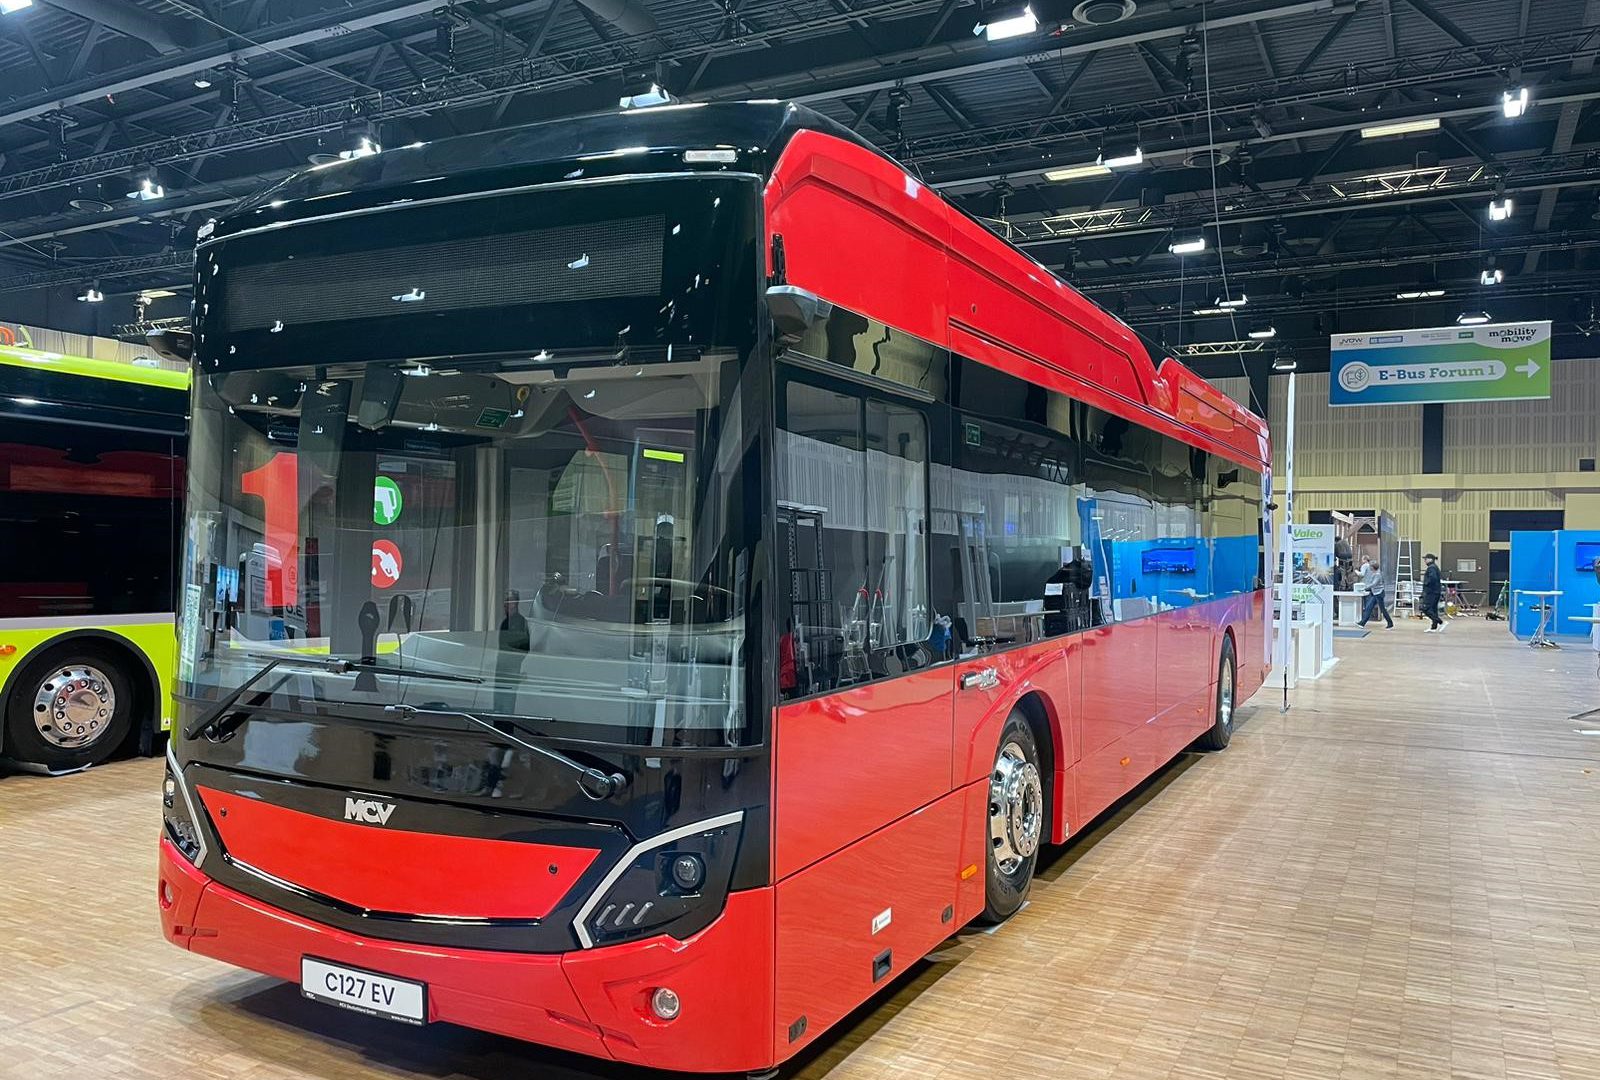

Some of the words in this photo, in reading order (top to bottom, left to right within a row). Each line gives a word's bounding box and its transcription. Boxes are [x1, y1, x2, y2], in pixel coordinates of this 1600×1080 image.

[1489, 327, 1537, 338] mobility
[1501, 335, 1532, 343] move
[1379, 369, 1425, 381] E-Bus
[1429, 366, 1484, 379] Forum
[1489, 365, 1496, 376] 1
[1293, 529, 1323, 538] Valeo
[344, 797, 397, 825] MCV
[325, 972, 366, 999] C127
[371, 983, 395, 1006] EV
